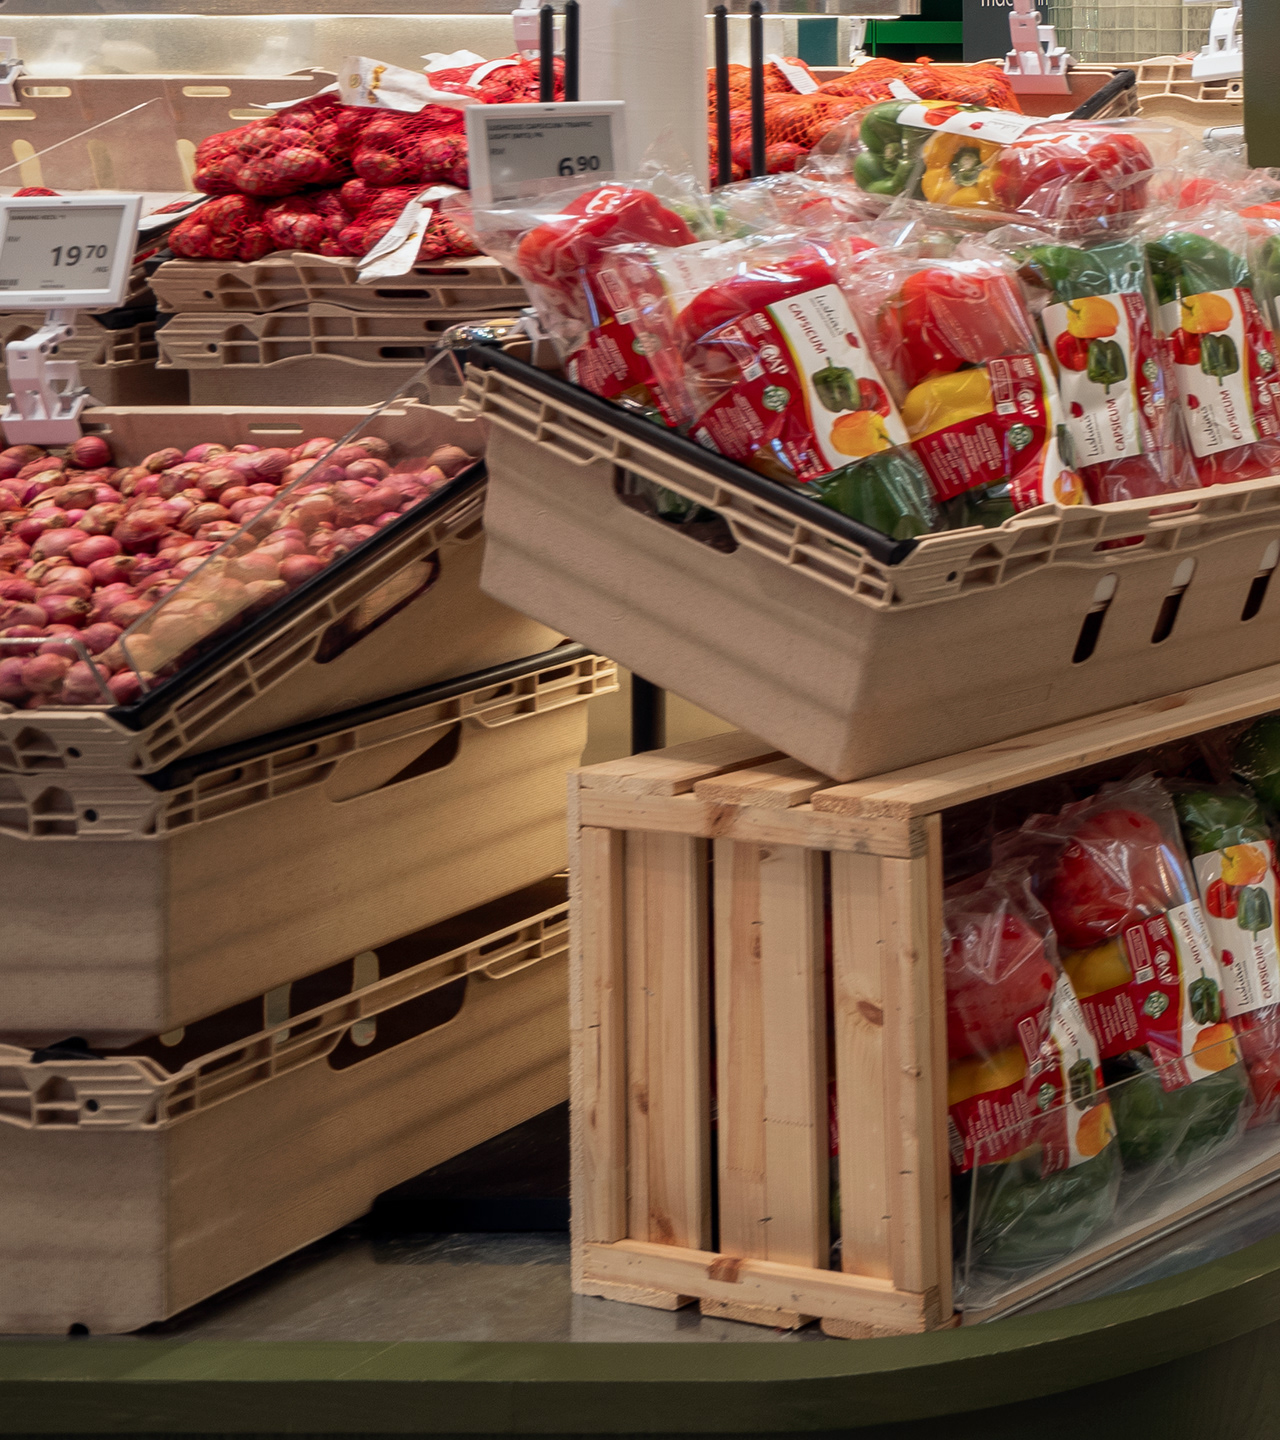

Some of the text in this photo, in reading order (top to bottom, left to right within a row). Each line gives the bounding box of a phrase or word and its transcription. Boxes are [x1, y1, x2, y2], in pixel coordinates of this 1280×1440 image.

[787, 303, 828, 355] CAPSICUM
[1106, 398, 1126, 452] CAPSICUM
[1219, 389, 1244, 441] CAPSICUM
[1178, 911, 1202, 965] CAPSICUM
[1253, 944, 1273, 1000] CAPSICUM
